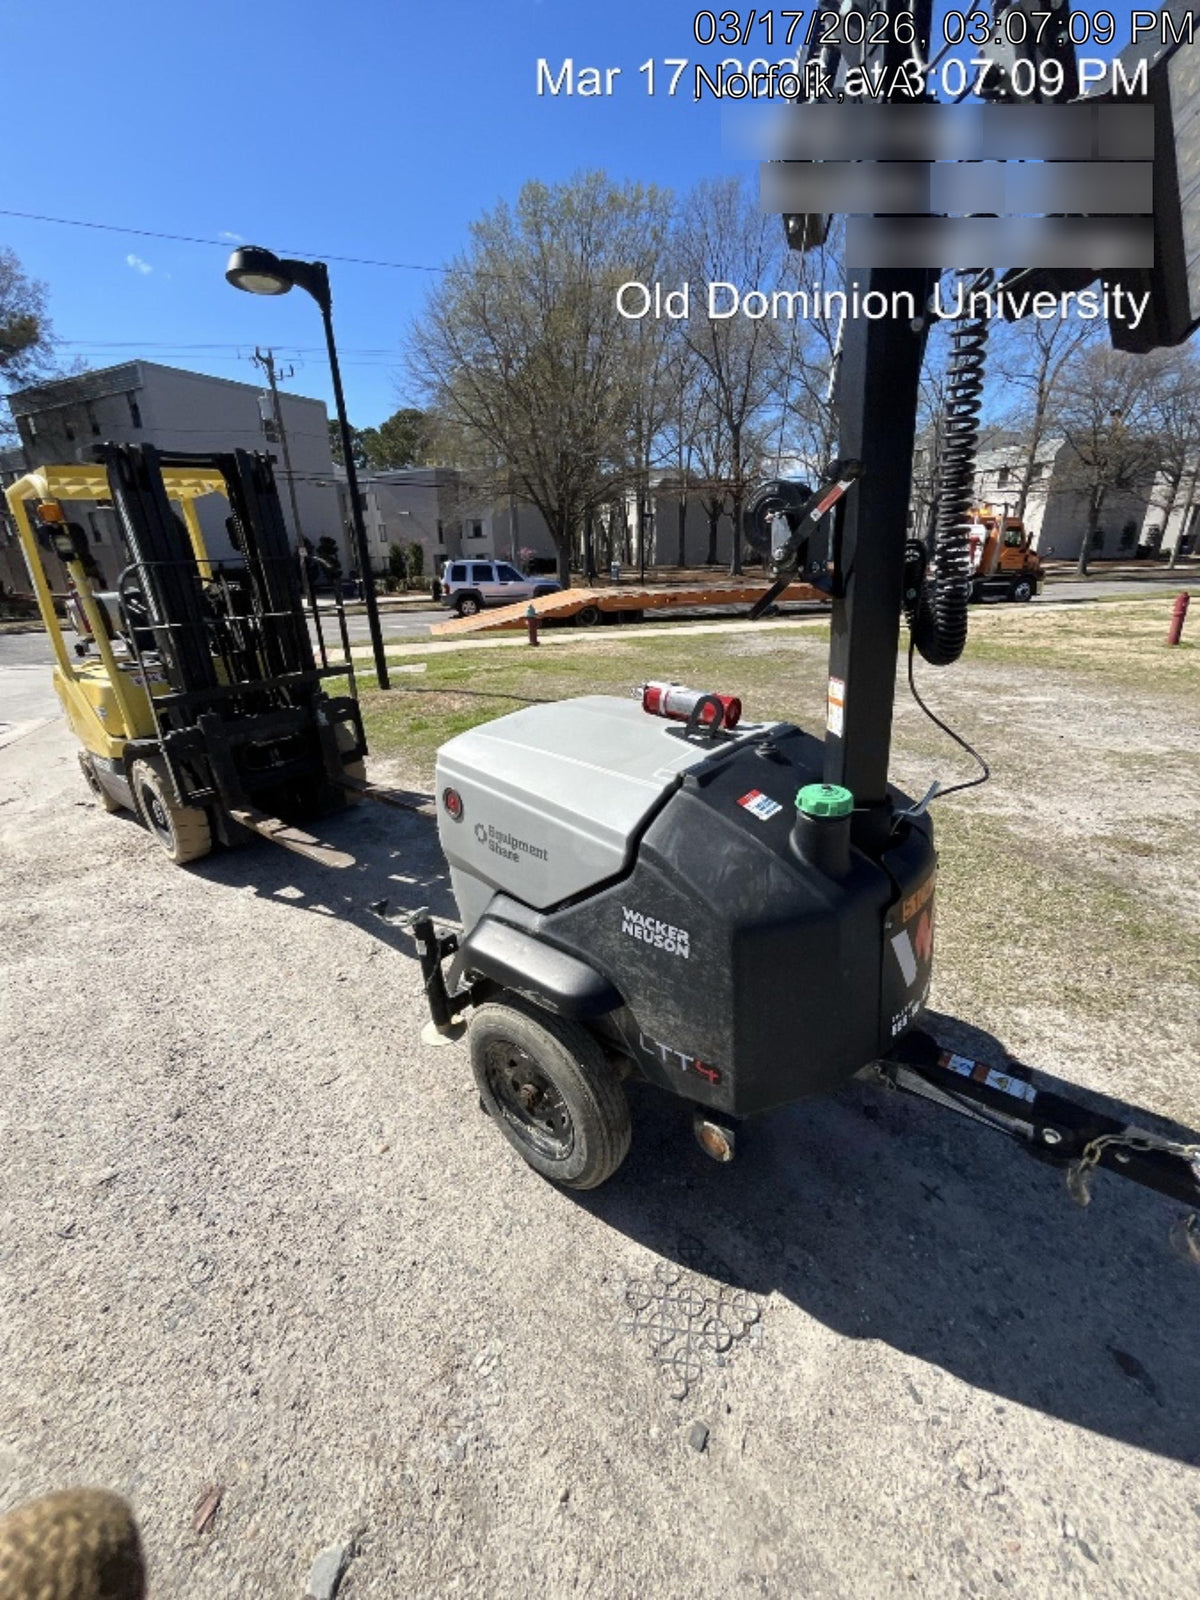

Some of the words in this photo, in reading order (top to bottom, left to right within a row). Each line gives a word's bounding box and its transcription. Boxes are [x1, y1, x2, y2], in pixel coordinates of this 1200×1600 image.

[488, 824, 549, 861] Equipment
[488, 839, 520, 863] Share
[621, 905, 690, 947] WACKER
[621, 920, 690, 959] NEUSON
